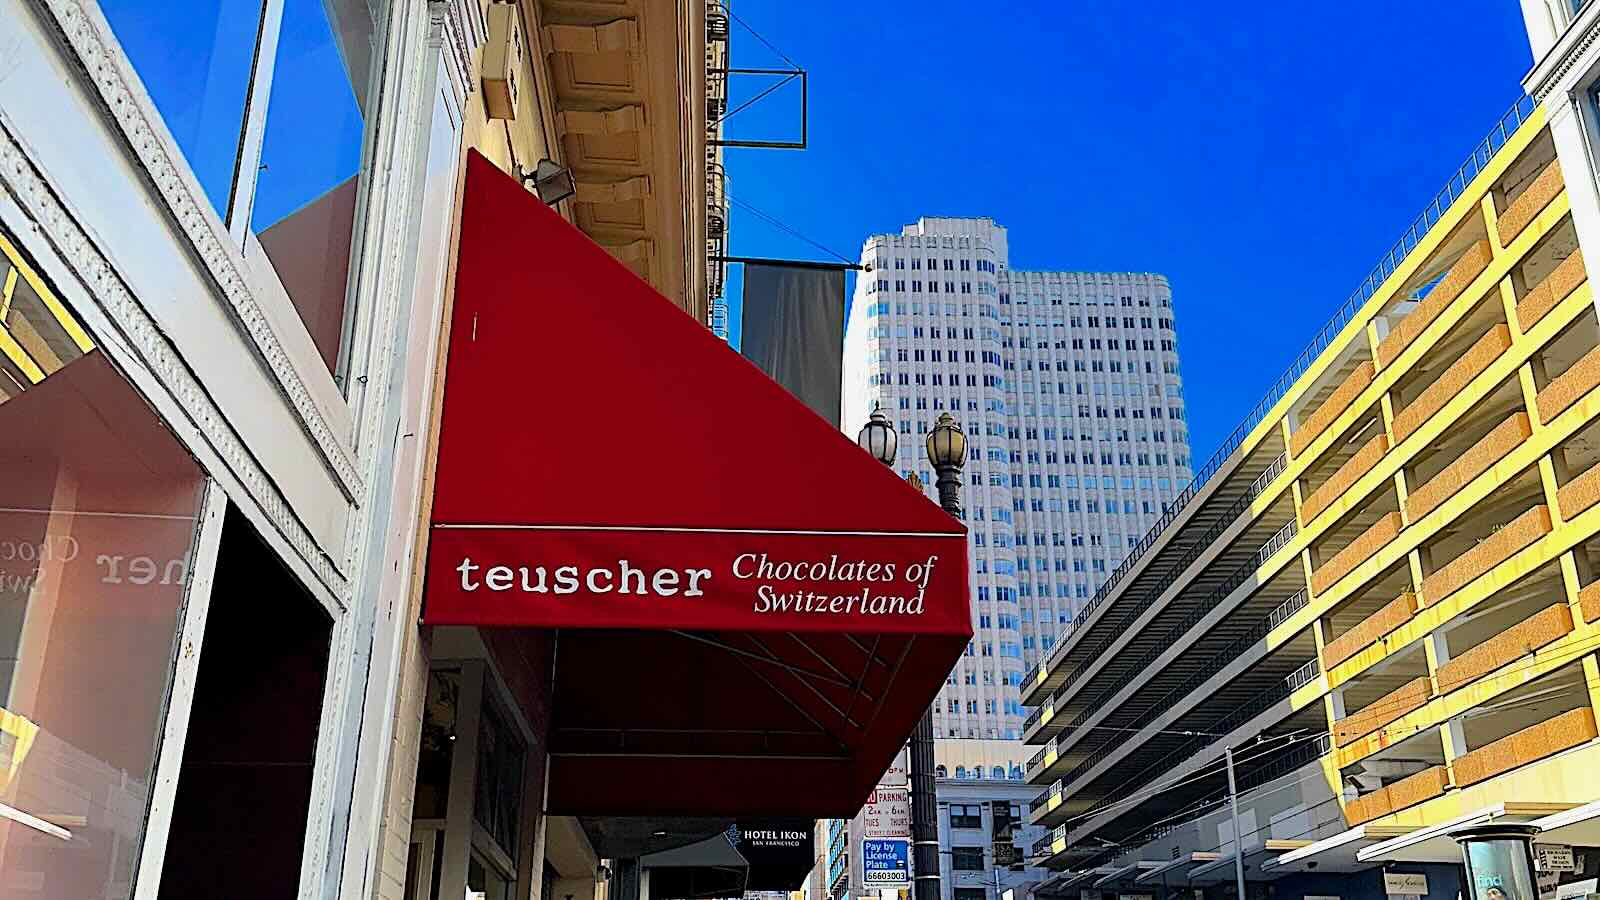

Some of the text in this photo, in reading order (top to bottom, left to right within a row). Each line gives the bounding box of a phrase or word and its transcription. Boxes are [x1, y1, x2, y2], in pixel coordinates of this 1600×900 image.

[456, 553, 938, 598] teuscher Chocolates of
[753, 584, 926, 616] Switzerland
[879, 792, 907, 802] PARKING
[865, 818, 908, 827] TUES THURS
[744, 830, 807, 840] HOTEL IKON
[865, 842, 895, 852] Pay by
[865, 851, 898, 860] License
[865, 860, 889, 869] Plate
[867, 872, 905, 880] 66603003
